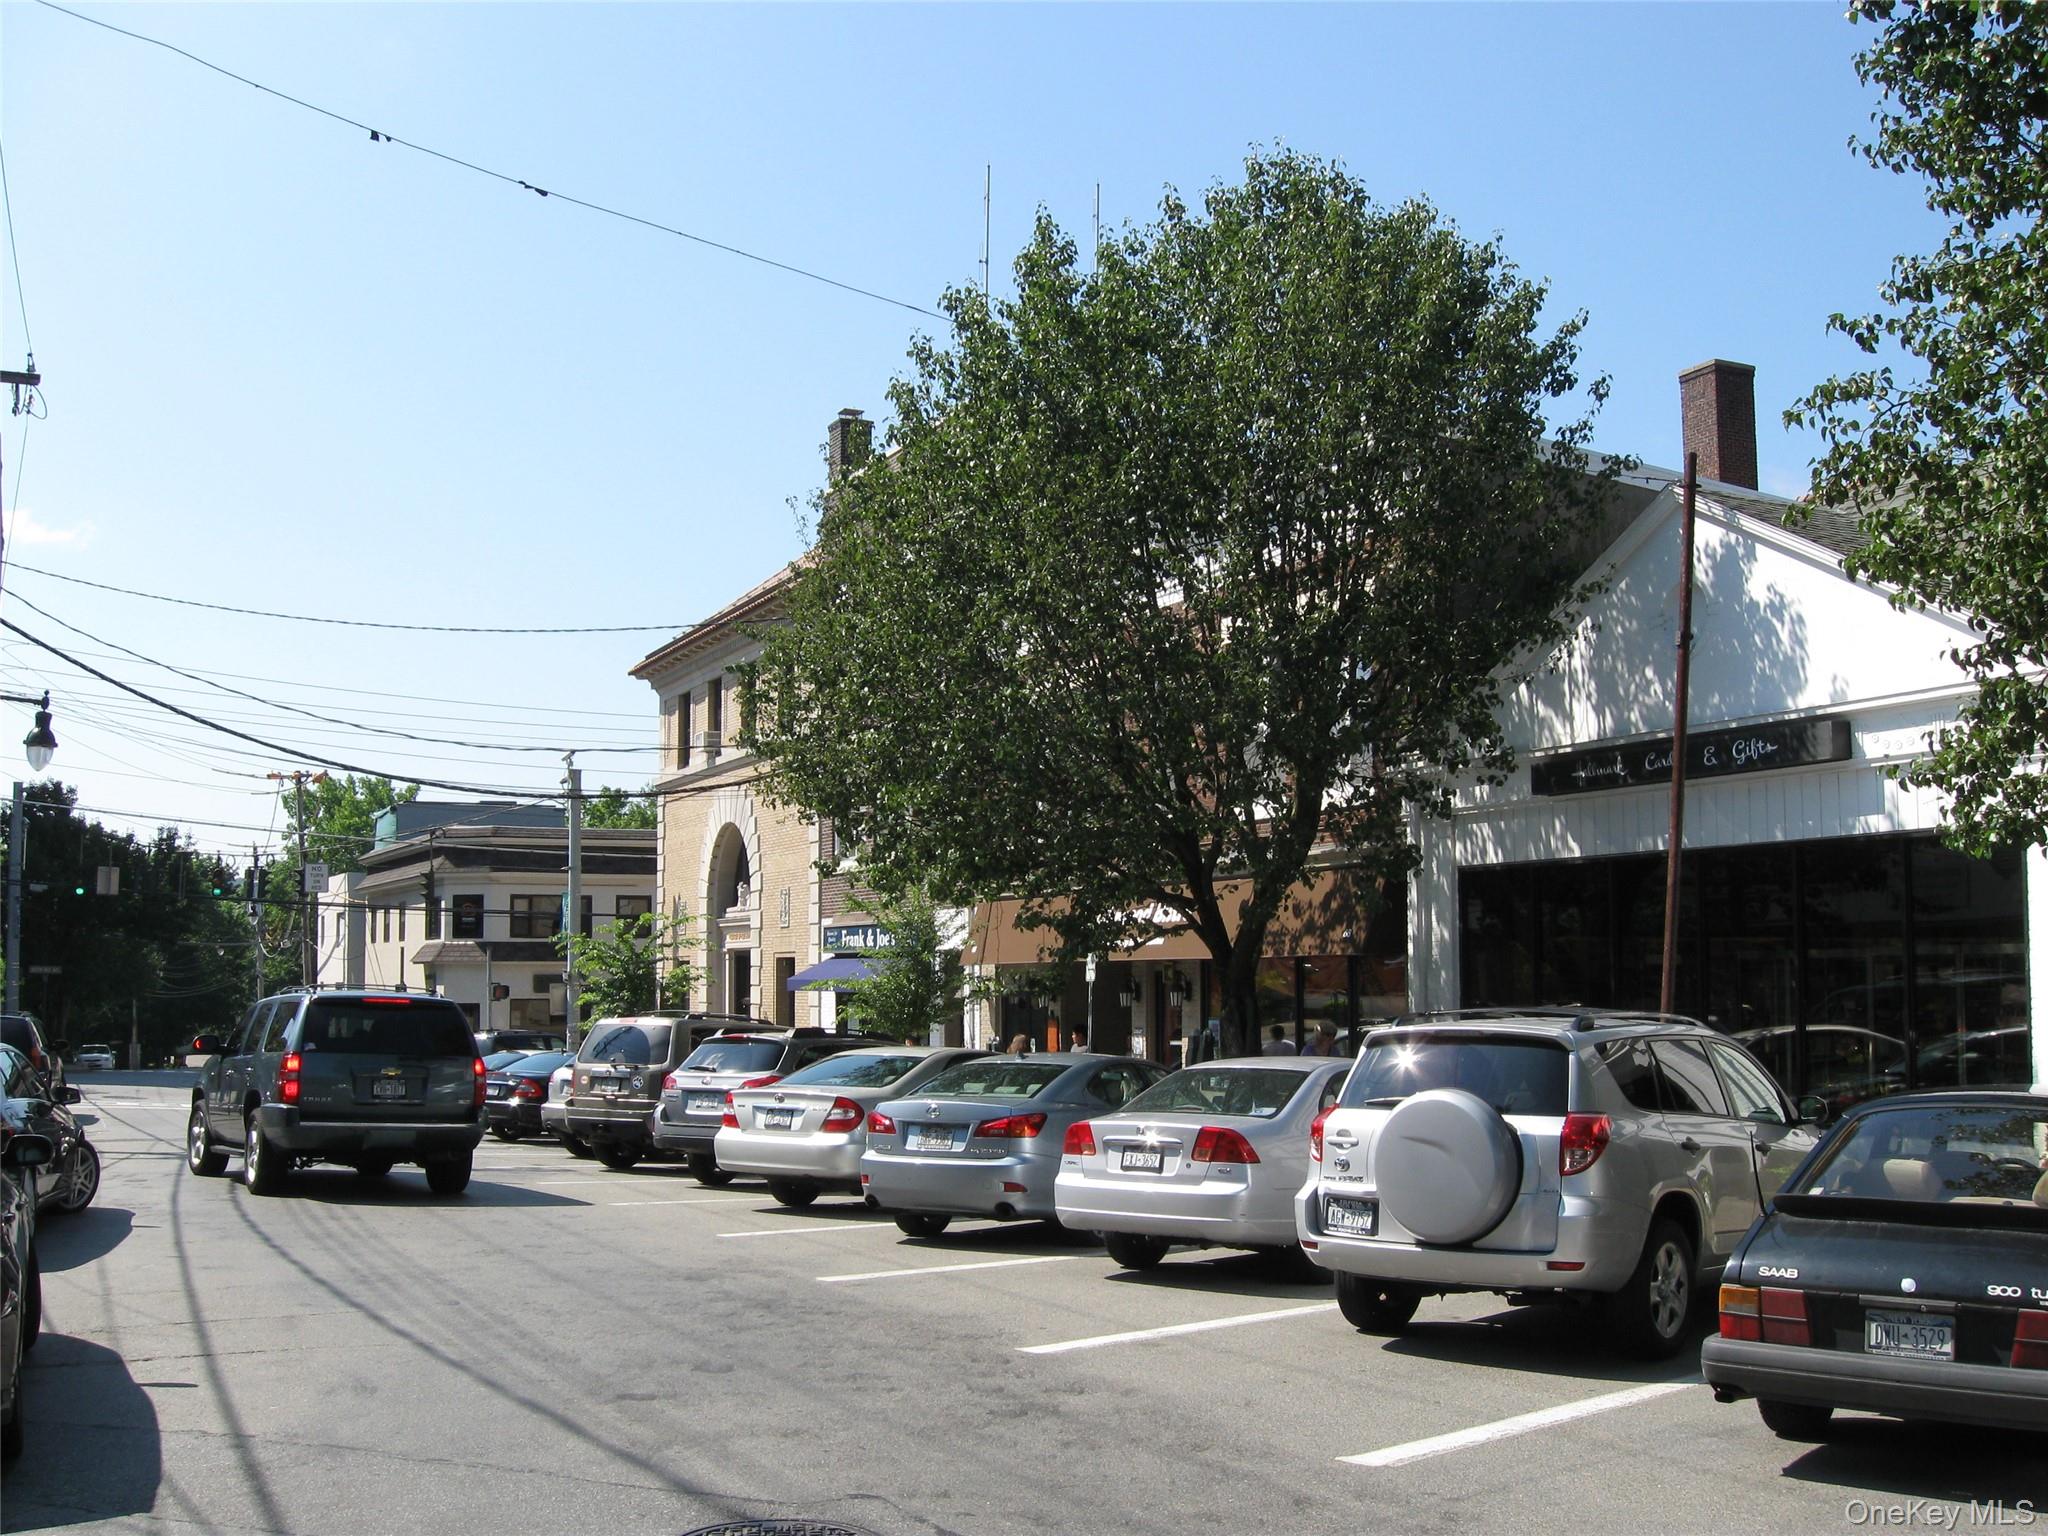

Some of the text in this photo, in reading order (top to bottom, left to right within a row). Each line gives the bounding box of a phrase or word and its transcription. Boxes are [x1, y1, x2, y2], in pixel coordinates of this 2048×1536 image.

[1645, 751, 1673, 770] Card
[1704, 747, 1717, 765] &
[1732, 740, 1778, 766] Gifts
[841, 929, 865, 948] Frank
[866, 928, 874, 947] &
[876, 928, 896, 950] Joe's
[1758, 1266, 1799, 1279] SAAB
[1987, 1285, 2022, 1298] 900
